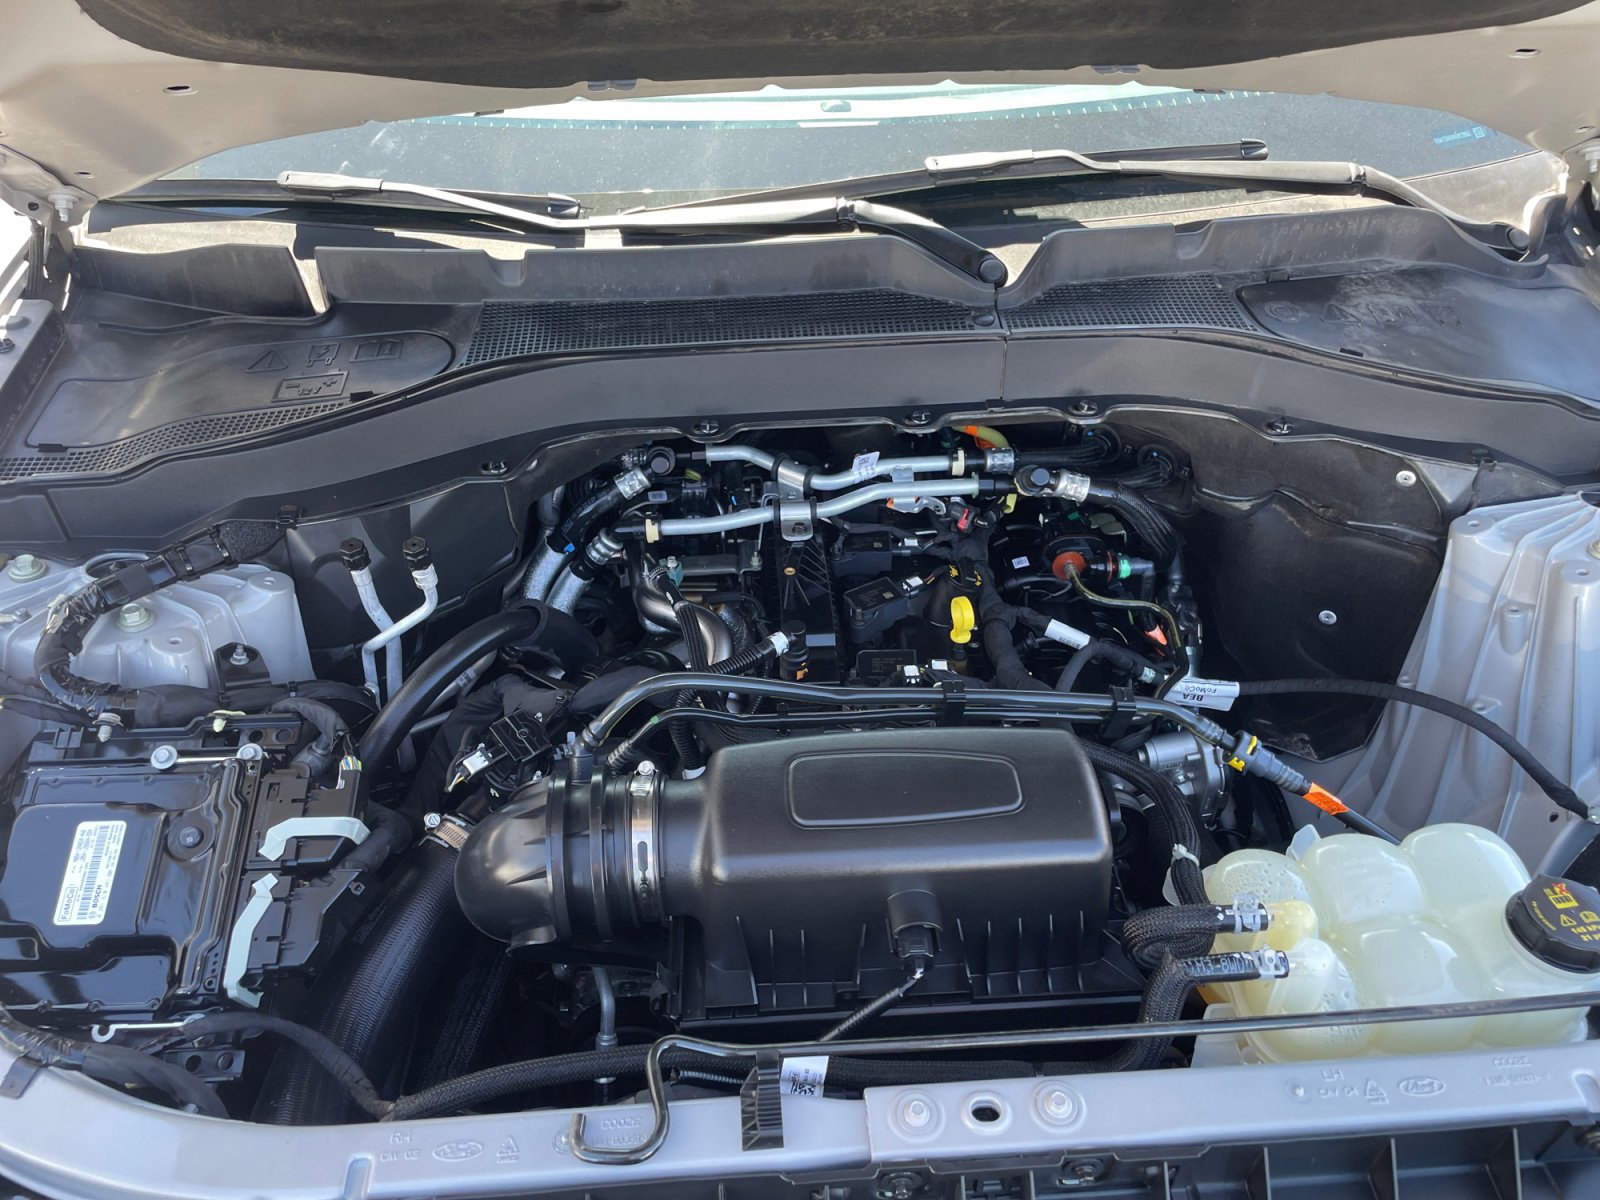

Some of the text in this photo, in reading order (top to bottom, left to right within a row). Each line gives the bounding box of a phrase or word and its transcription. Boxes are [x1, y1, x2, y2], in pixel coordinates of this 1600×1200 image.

[1183, 693, 1204, 702] BEA
[62, 888, 75, 920] FoMoCo
[91, 884, 102, 909] BOSCH
